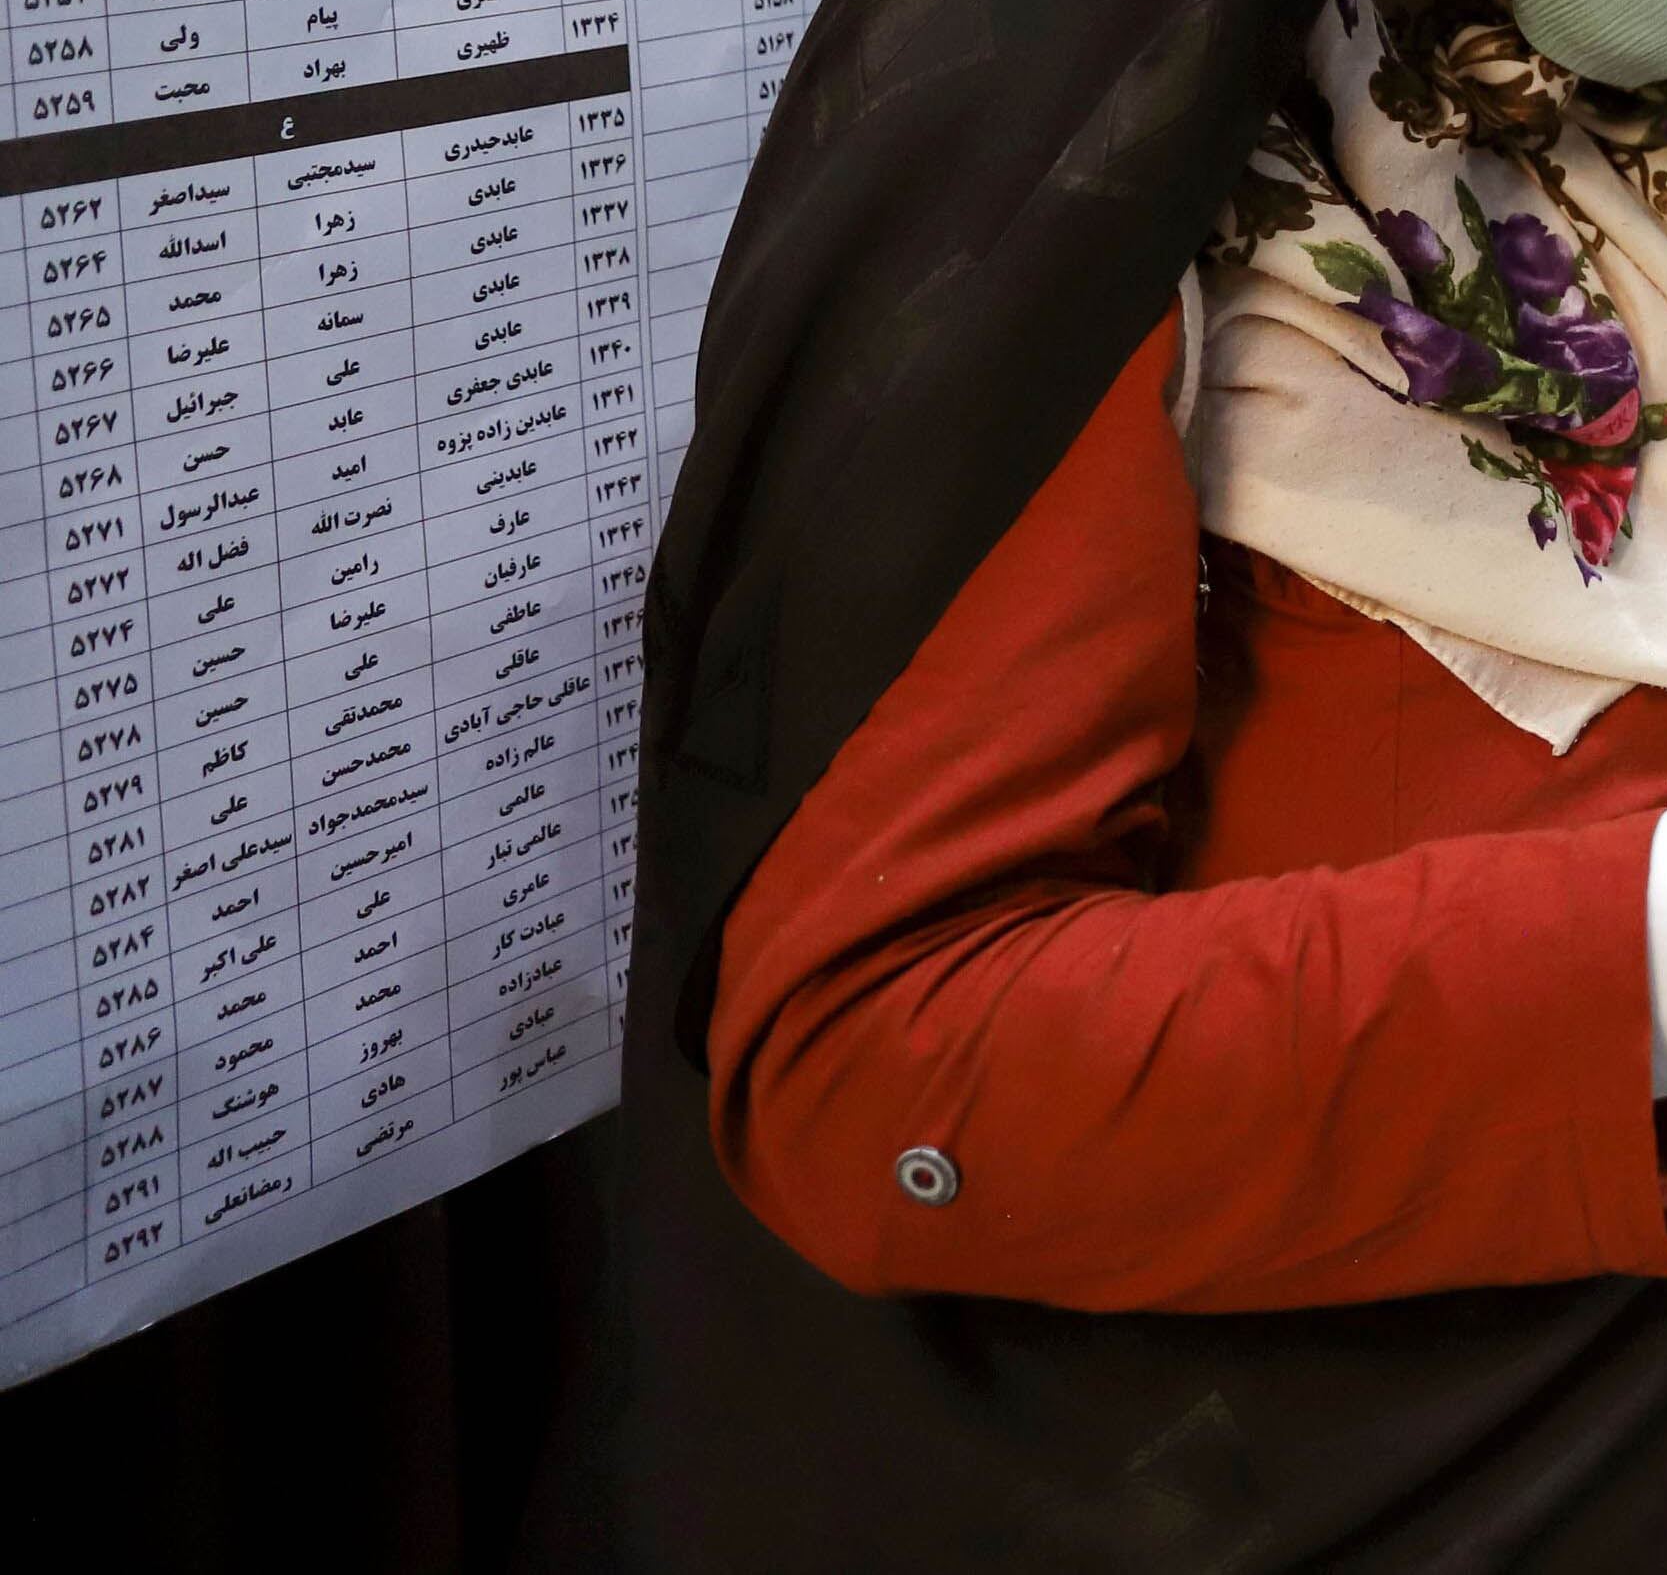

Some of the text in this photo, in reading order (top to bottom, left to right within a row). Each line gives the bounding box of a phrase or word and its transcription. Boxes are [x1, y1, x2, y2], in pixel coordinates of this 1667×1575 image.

[159, 23, 200, 53] ولی
[306, 6, 339, 34] پیام
[27, 35, 94, 66] ۵۲۵۸
[281, 117, 294, 139] ع
[51, 247, 630, 392] ۱۳۳۸ عابدی سمانه علیرضا ۵۲۶۶
[594, 428, 637, 457] ۱۳۴۲
[476, 459, 538, 496] عابدینی
[67, 566, 130, 605] ۵۲۷۲
[83, 648, 540, 814] عاقلی محمدتقی کاظم ۵۲۷۹
[89, 874, 150, 917] ۵۲۸۲
[98, 872, 550, 1069] عامری احمد محمد ۵۲۸۶
[509, 1006, 555, 1042] عبادی
[360, 1073, 406, 1109] هادی
[355, 1119, 415, 1158] مرتضی
[105, 1174, 160, 1215] ۵۲۹۱
[204, 1176, 293, 1226] رمضانعلی
[104, 1221, 164, 1264] ۵۲۹۲
